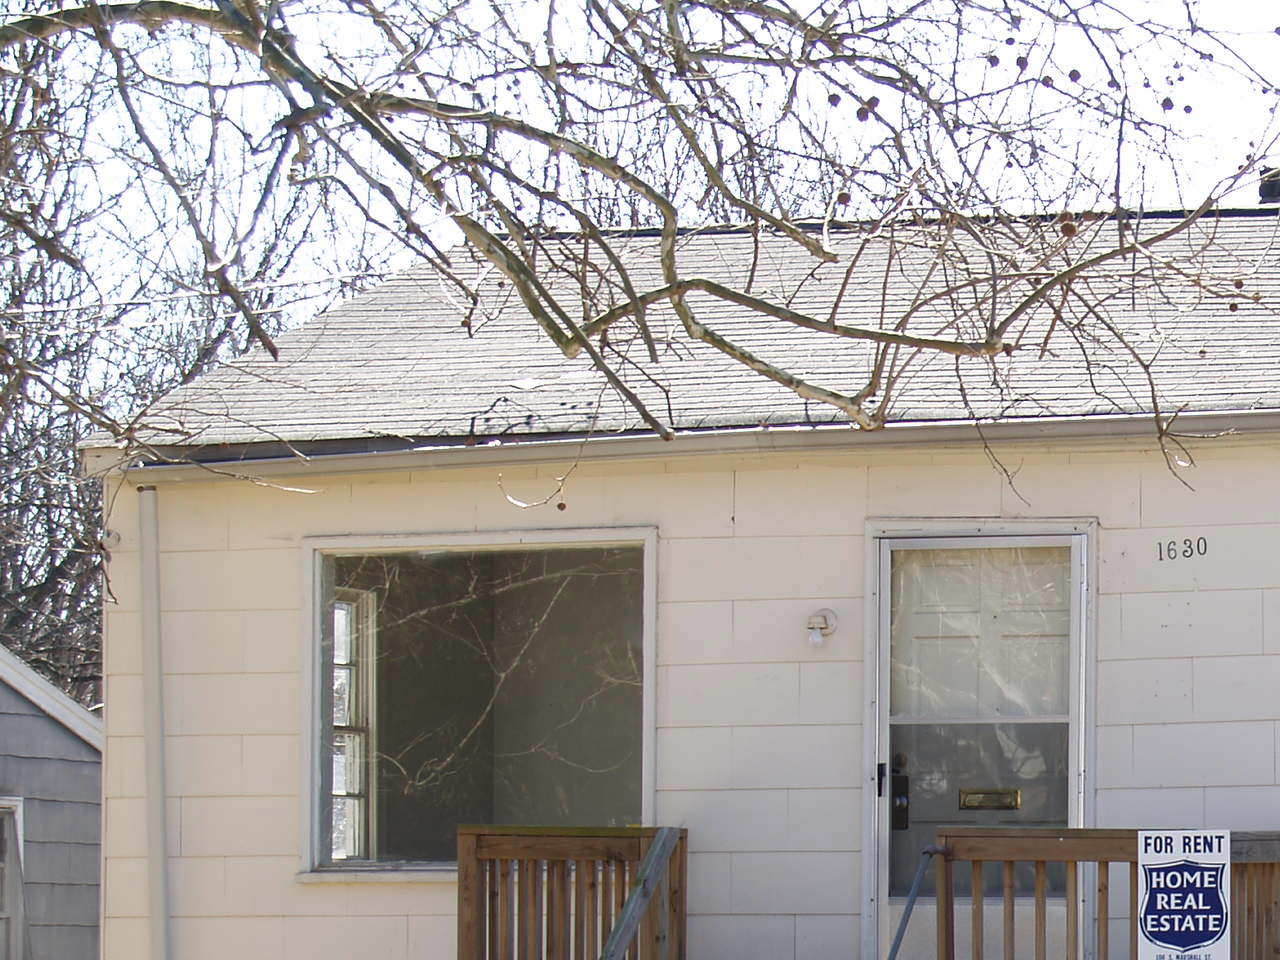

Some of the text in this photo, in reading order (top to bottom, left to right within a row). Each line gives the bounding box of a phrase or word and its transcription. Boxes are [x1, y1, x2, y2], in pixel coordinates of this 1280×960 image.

[1158, 537, 1207, 561] 1630
[1144, 836, 1224, 853] FOR RENT
[1151, 871, 1216, 888] HOME
[1156, 893, 1211, 910] REAL
[1146, 914, 1221, 932] ESTATE
